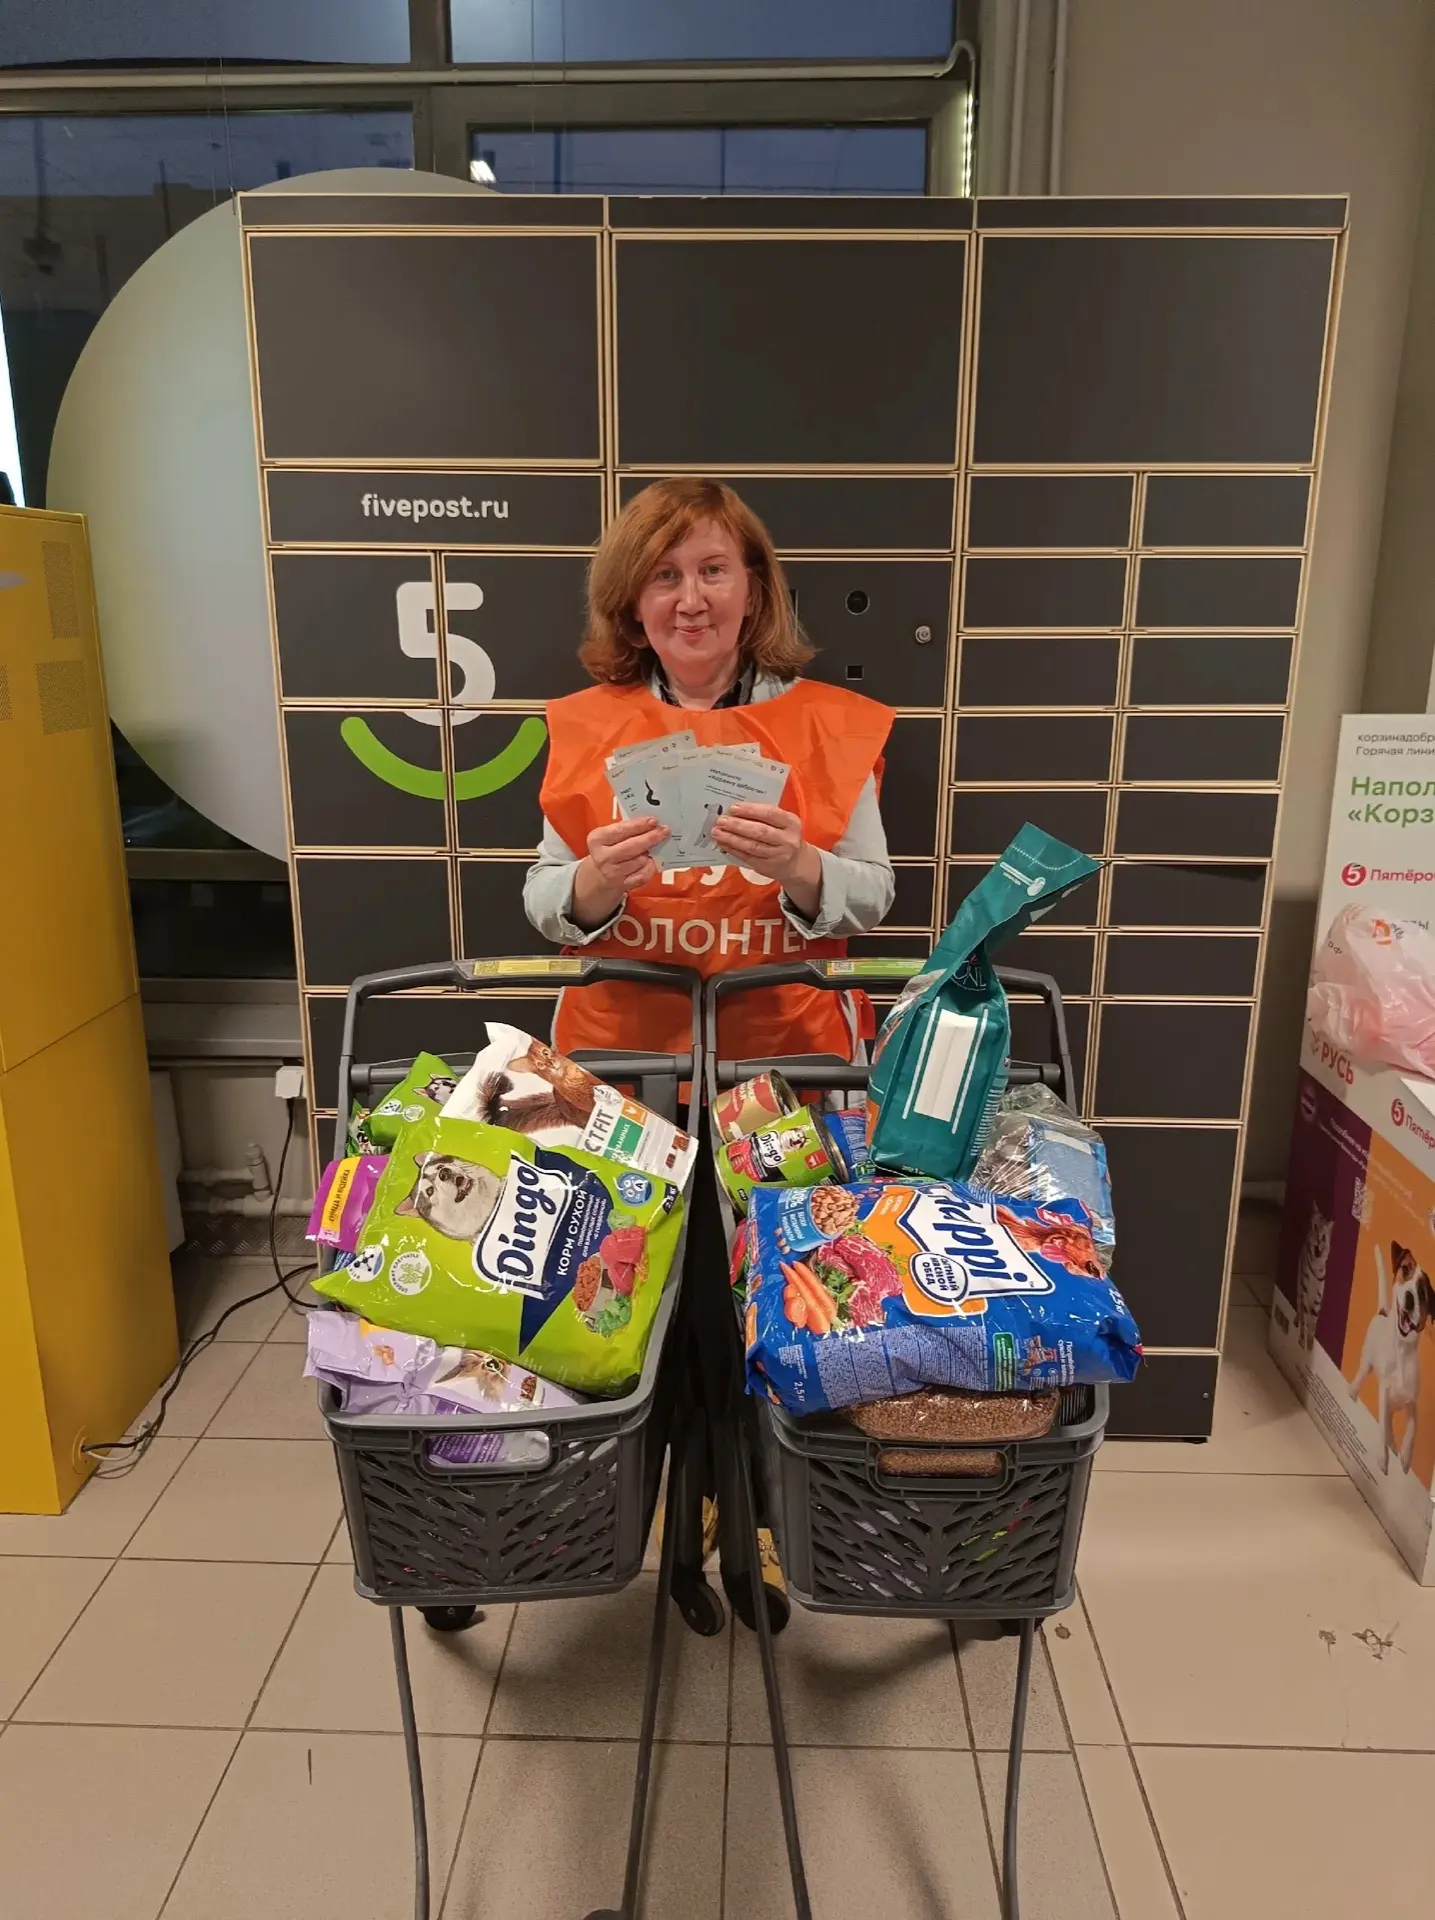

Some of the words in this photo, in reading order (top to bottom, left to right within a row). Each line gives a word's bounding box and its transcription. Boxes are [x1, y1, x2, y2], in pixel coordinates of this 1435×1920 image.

[361, 493, 509, 524] fivepost.ru
[396, 581, 496, 727] 5
[1355, 746, 1404, 756] Горячая
[1351, 776, 1435, 797] Напол
[1347, 803, 1435, 827] «Корз
[599, 914, 808, 955] ОЛОНТЕ
[1320, 1042, 1354, 1085] РУСЬ
[497, 1165, 557, 1278] Dingo
[557, 1237, 575, 1276] КОРМ
[568, 1188, 588, 1235] СУХОЙ
[922, 1261, 936, 1285] ОБЕД
